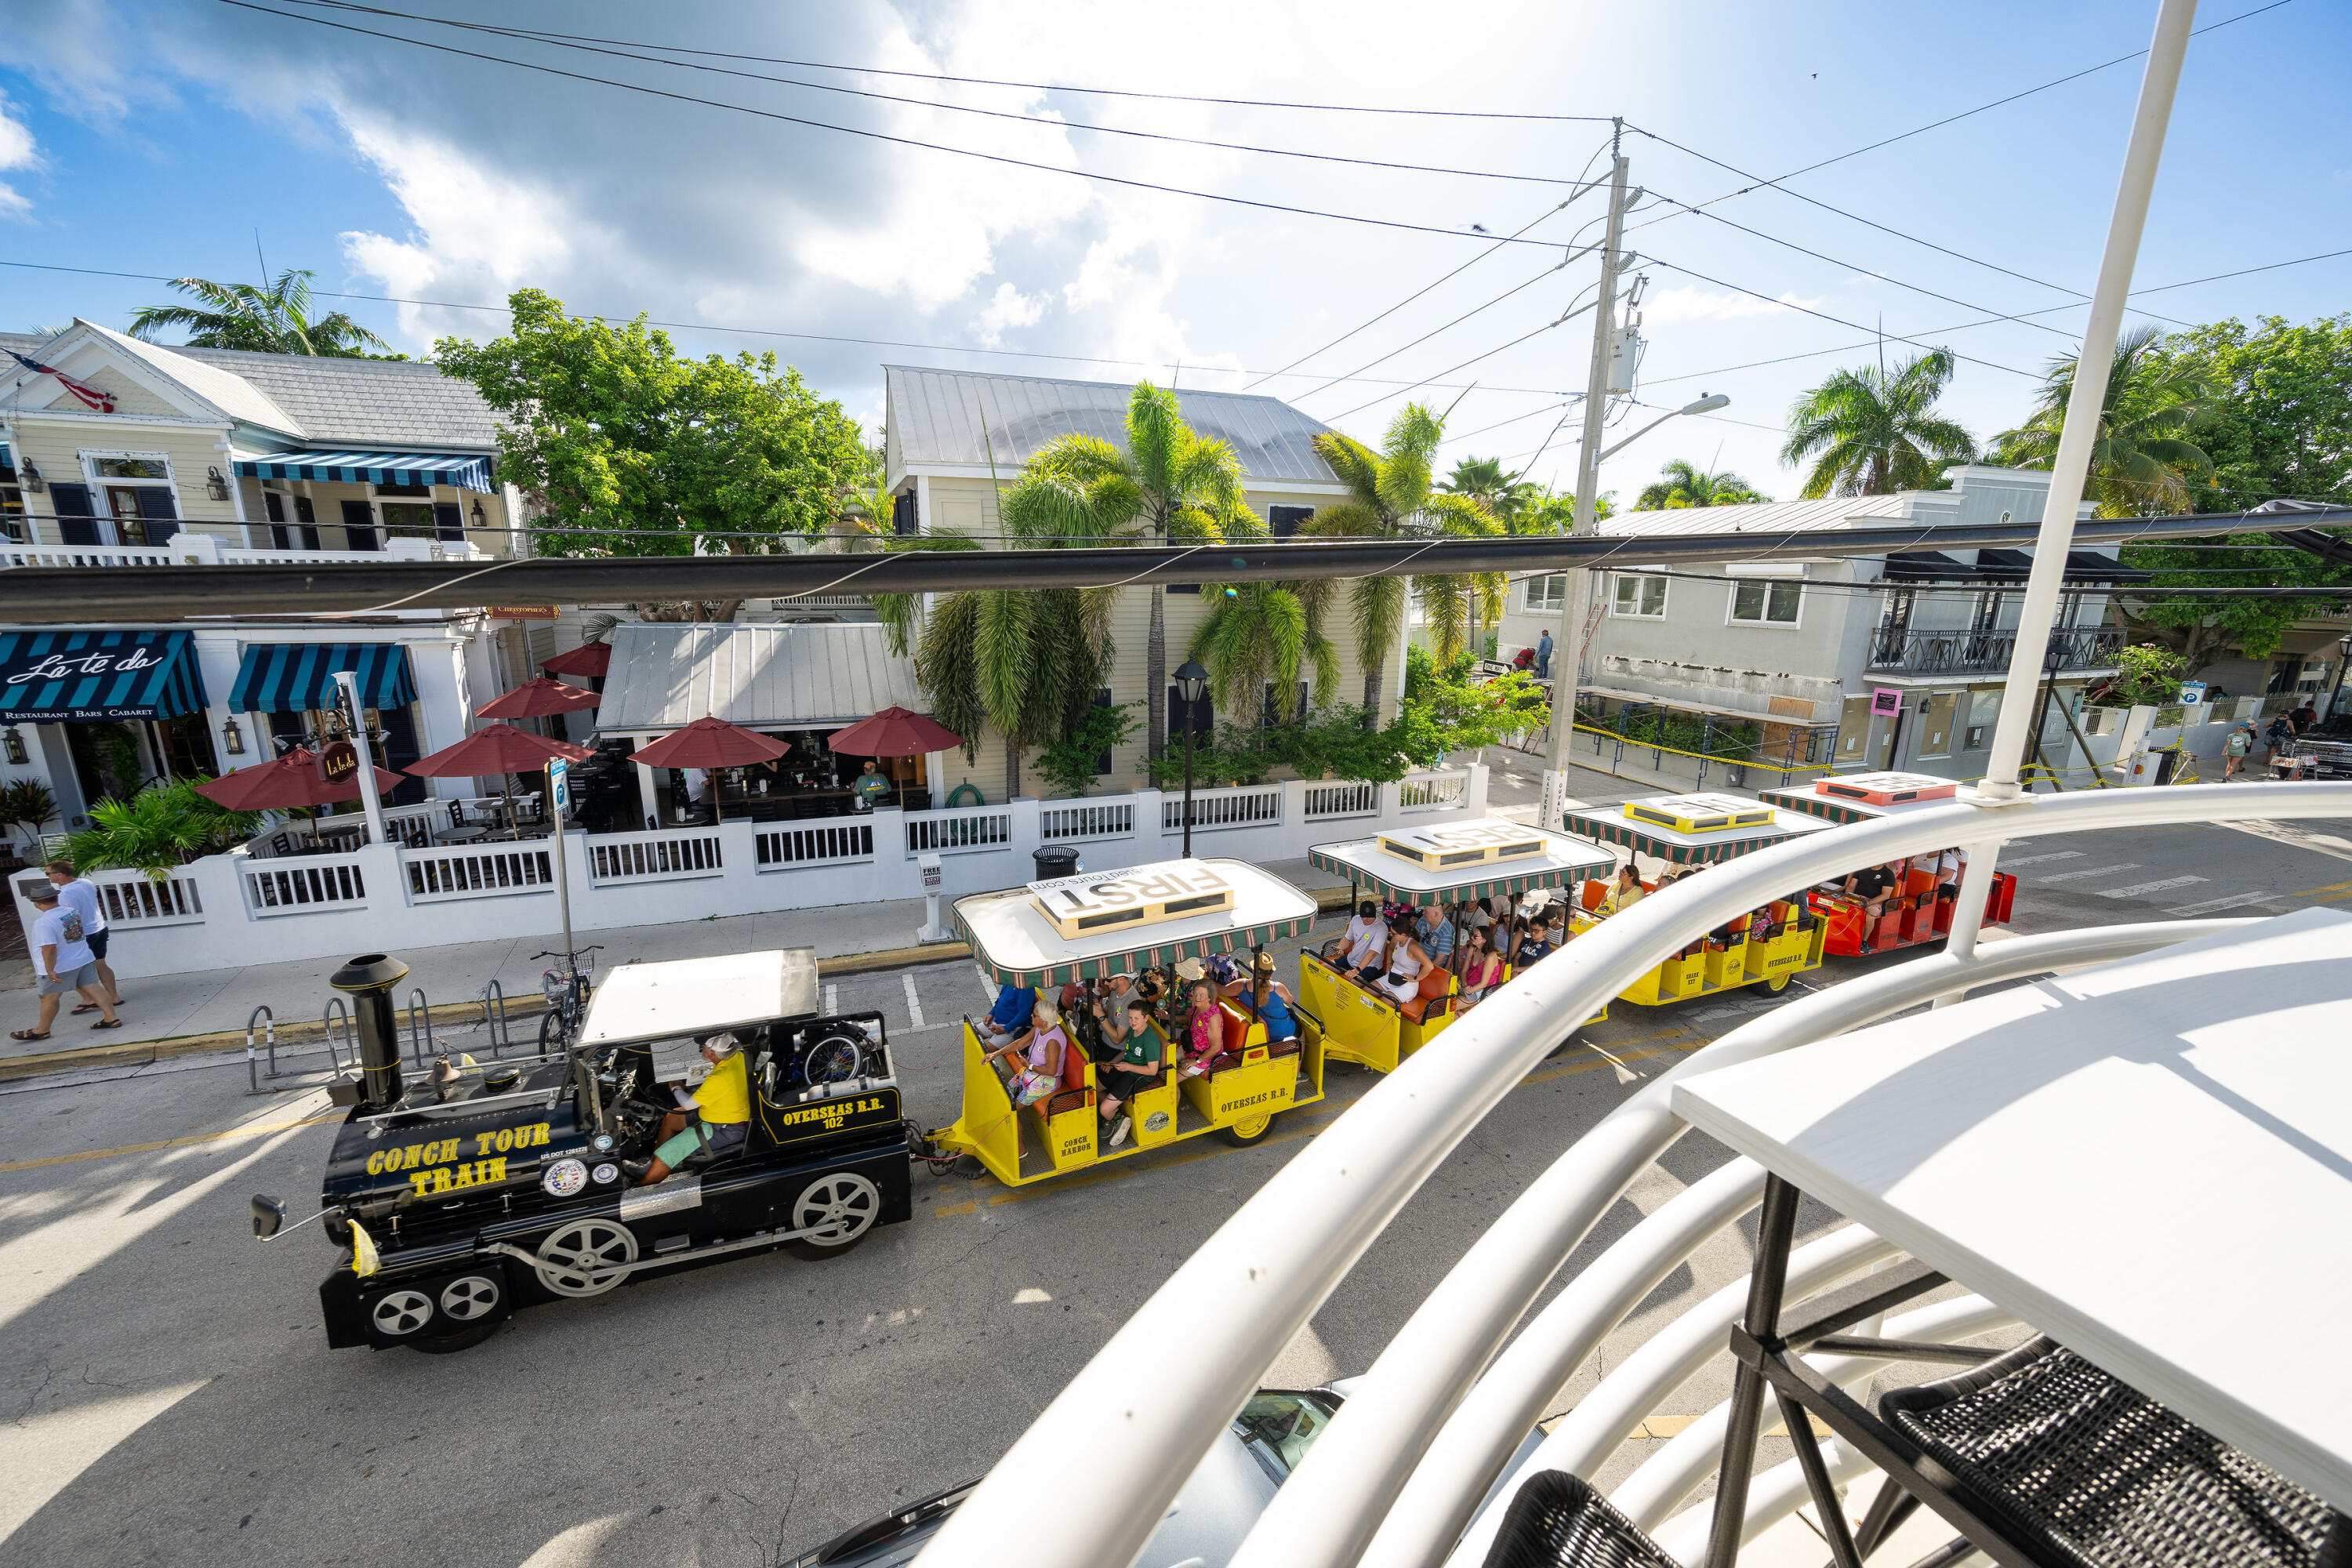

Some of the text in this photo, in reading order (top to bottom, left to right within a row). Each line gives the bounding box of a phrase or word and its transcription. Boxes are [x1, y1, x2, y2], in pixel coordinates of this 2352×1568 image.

[6, 648, 163, 684] La te da
[1541, 776, 1551, 827] CATHERINE
[1412, 825, 1539, 851] BEST
[1060, 867, 1229, 914] FIRST
[1767, 956, 1793, 968] OVERSEAS
[783, 1098, 885, 1125] OVERSEAS R.R.
[1221, 1087, 1288, 1112] OVERSEAS R.R.
[822, 1116, 844, 1129] 102
[366, 1122, 550, 1175] CONCH TOUR
[1062, 1142, 1091, 1157] HARBOR
[1064, 1135, 1087, 1148] CONCH
[409, 1156, 507, 1197] TRAIN
